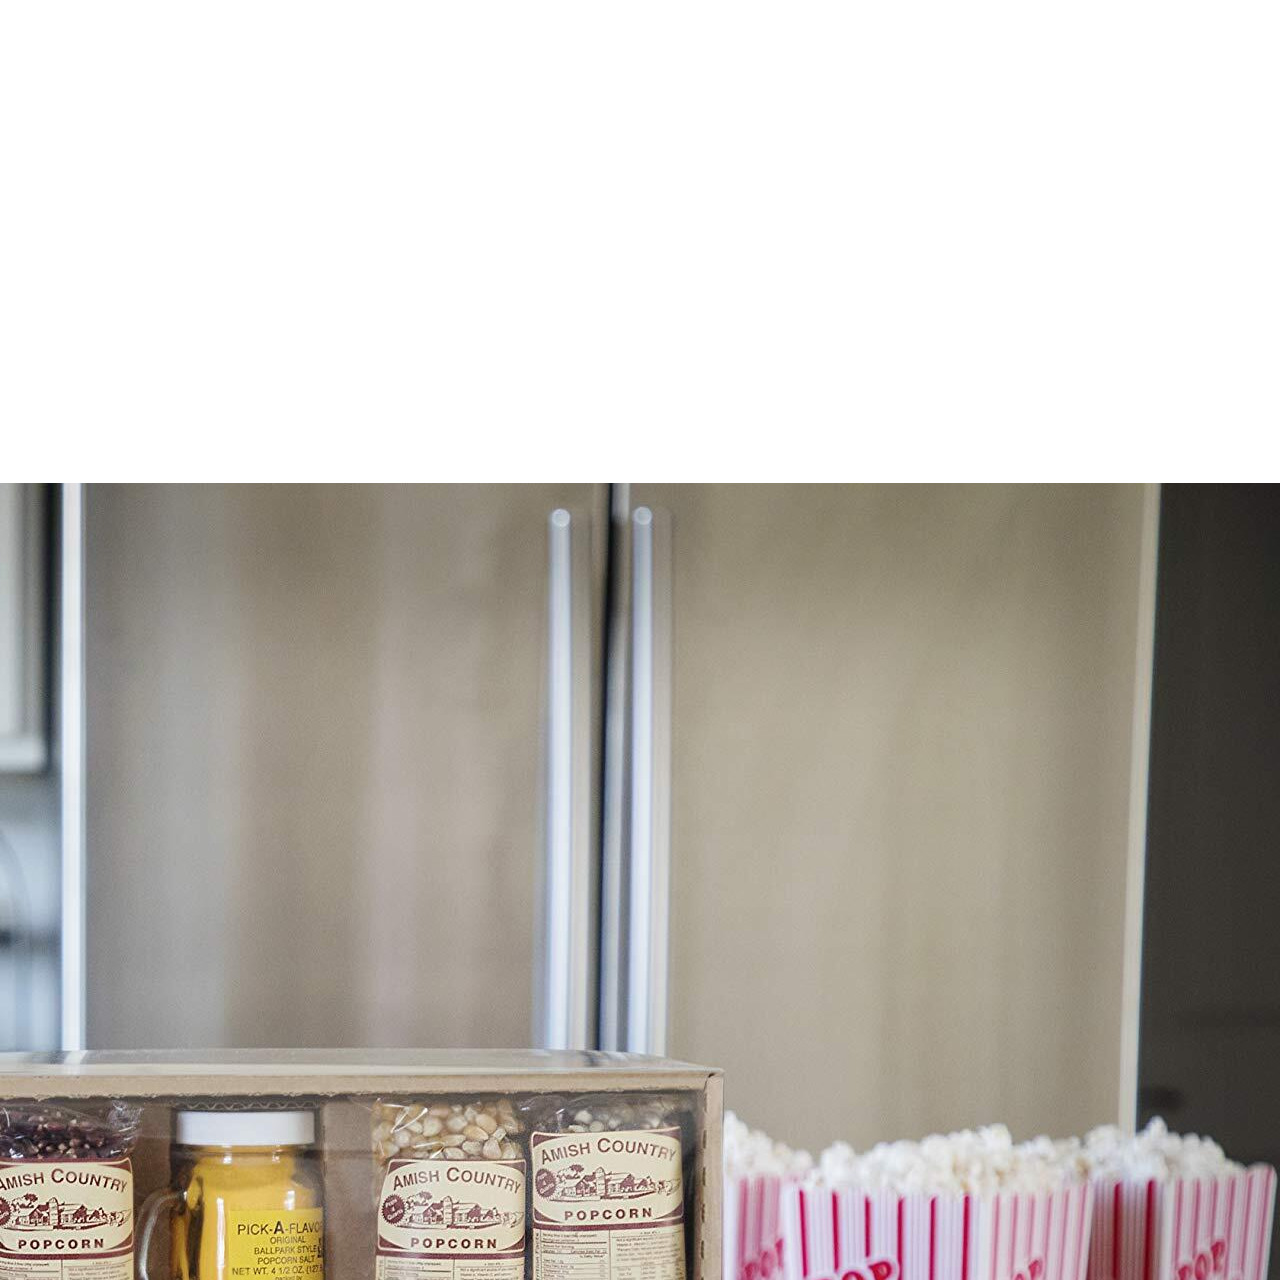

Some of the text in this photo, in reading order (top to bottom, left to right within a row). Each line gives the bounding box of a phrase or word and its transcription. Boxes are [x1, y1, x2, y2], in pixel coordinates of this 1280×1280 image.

[542, 1138, 676, 1164] AMISH COUNTRY
[51, 1168, 127, 1192] COUNTRY
[394, 1170, 440, 1190] AMISH
[447, 1167, 520, 1194] COUNTRY
[564, 1208, 652, 1220] POPCORN
[238, 1220, 322, 1236] PICK-A-FLAVO
[18, 1238, 104, 1250] POPCORN
[270, 1236, 306, 1244] ORIGINAL
[410, 1238, 497, 1248] POPCORN
[254, 1244, 316, 1254] BALLPARK STYLE
[258, 1256, 315, 1264] POPCORN SALT
[279, 1266, 290, 1274] 1/2
